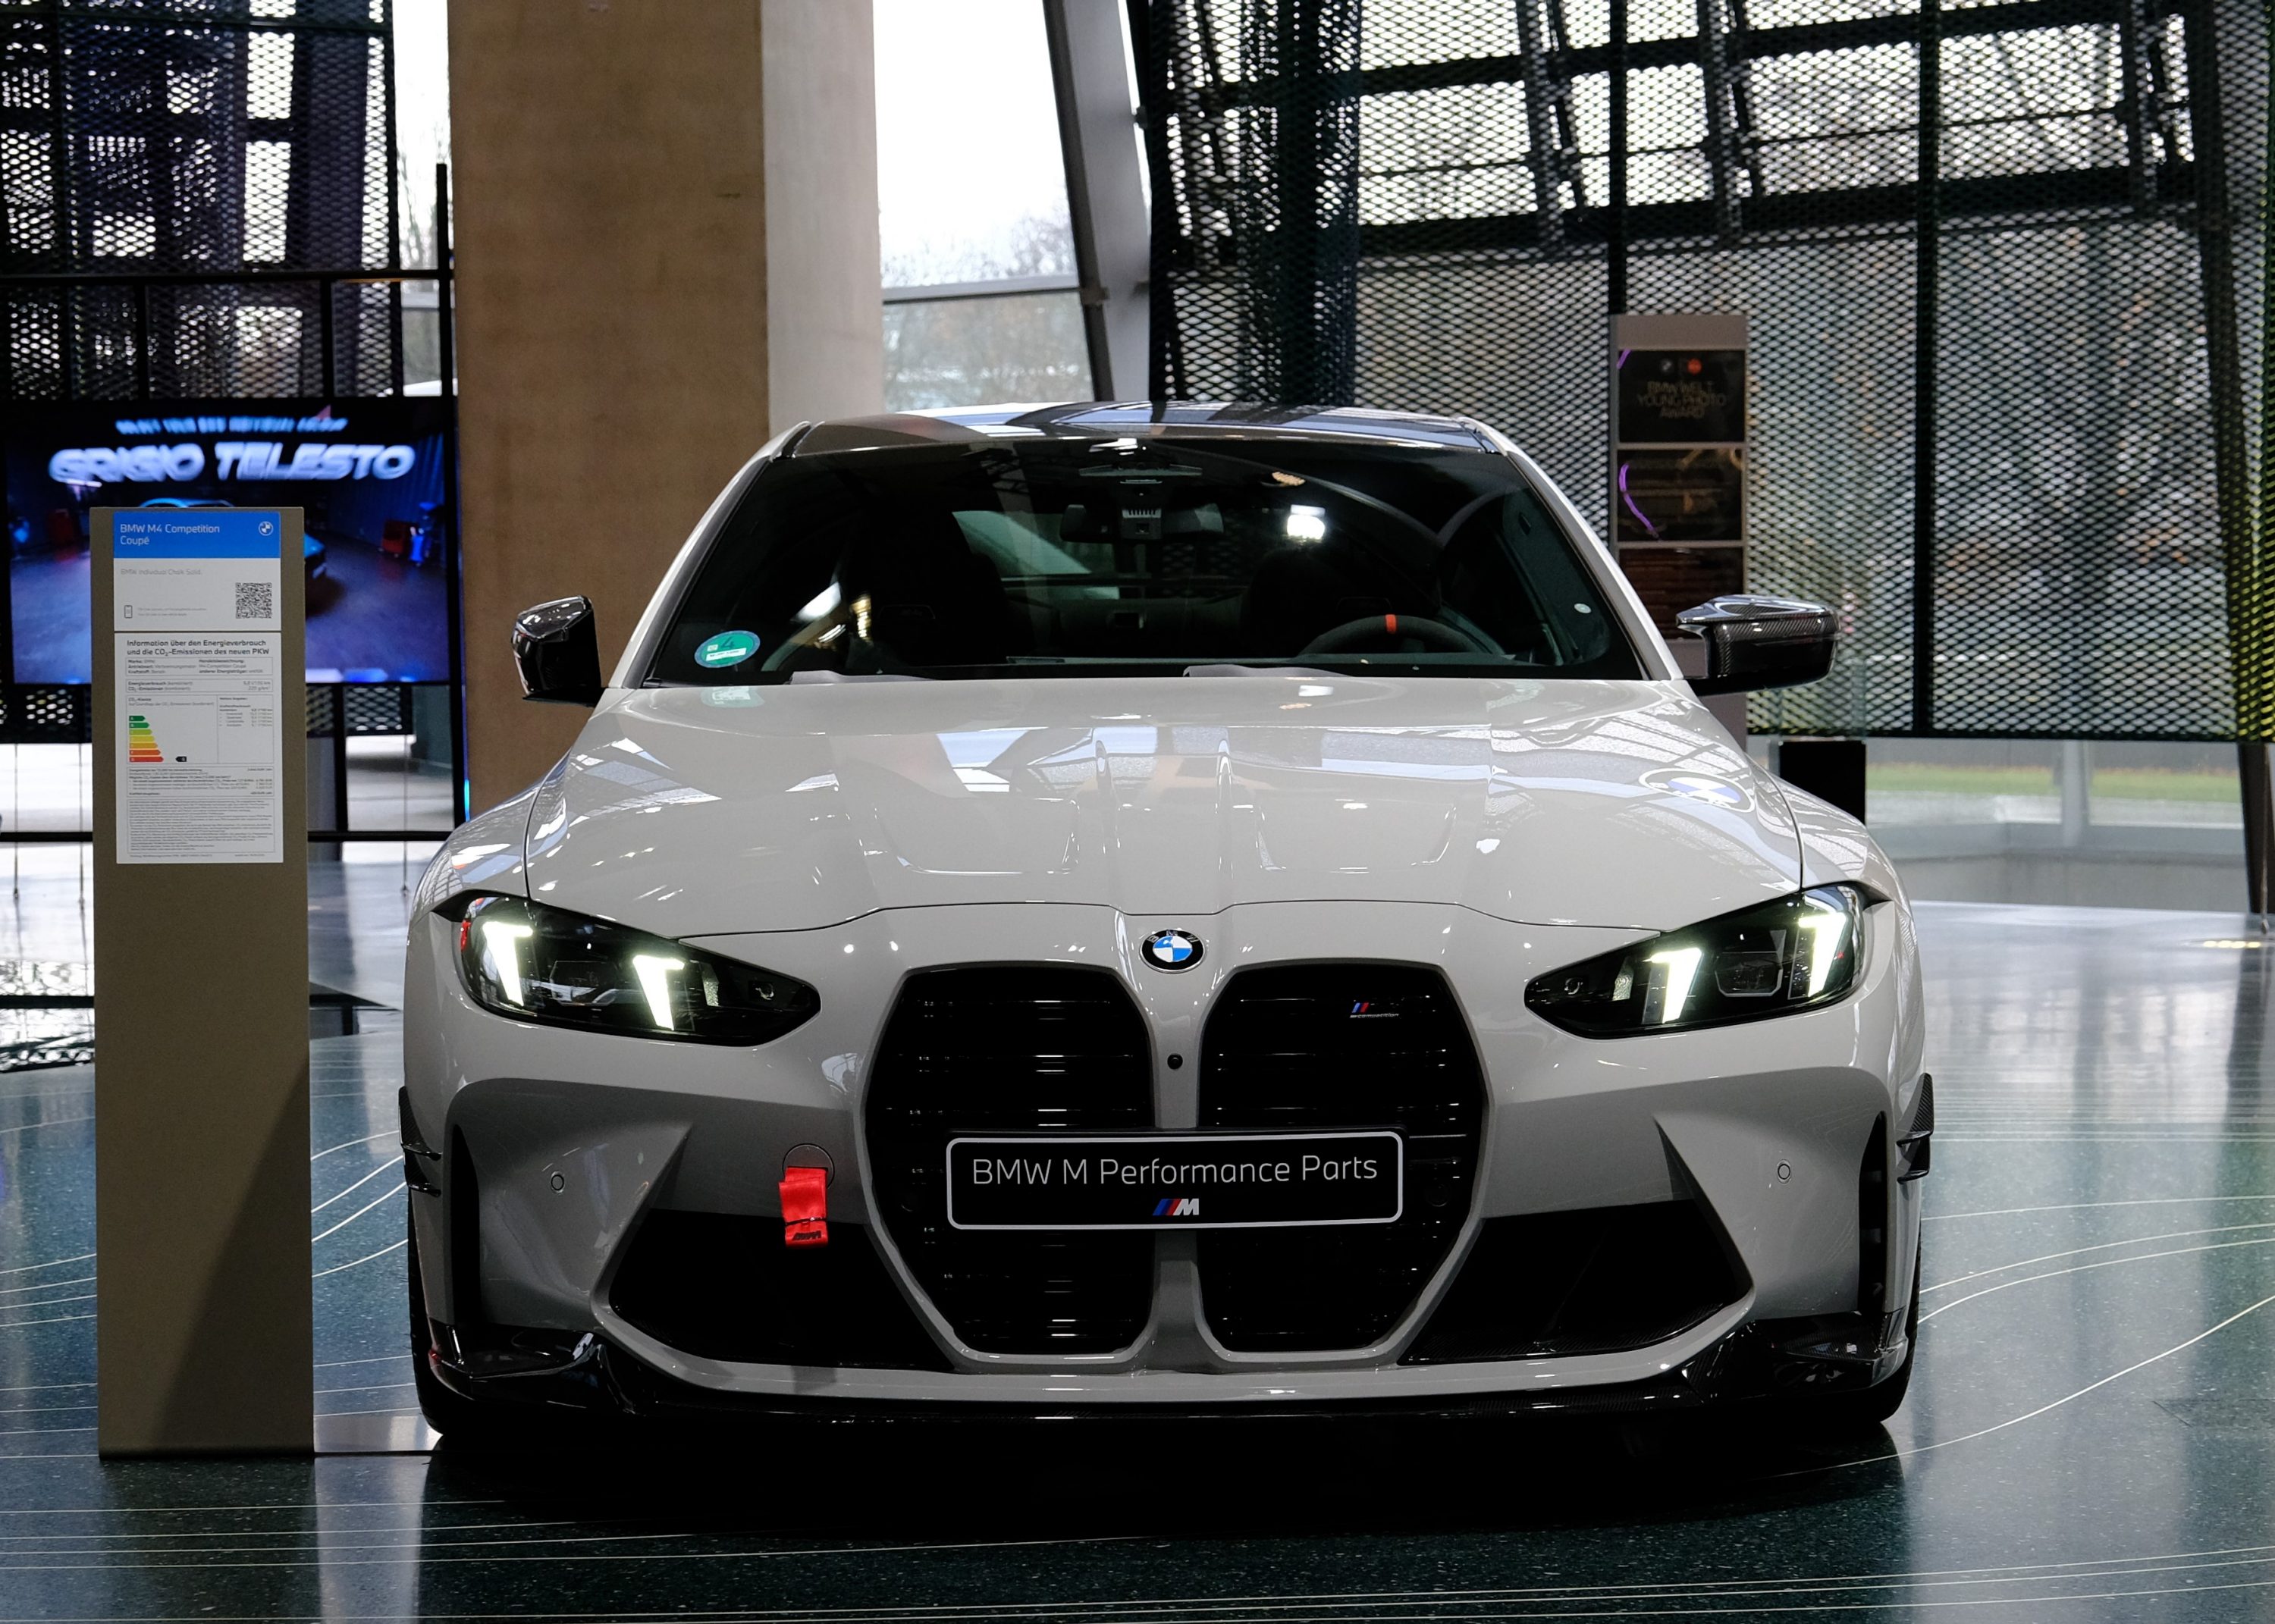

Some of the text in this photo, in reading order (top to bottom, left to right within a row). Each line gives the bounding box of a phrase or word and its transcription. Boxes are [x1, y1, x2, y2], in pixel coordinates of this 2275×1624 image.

[214, 440, 416, 481] TELESTO
[120, 524, 220, 535] BMW M4 Competition
[120, 535, 150, 545] Coupé
[720, 636, 735, 650] 4
[972, 1154, 1379, 1185] BMW M Performance Parts
